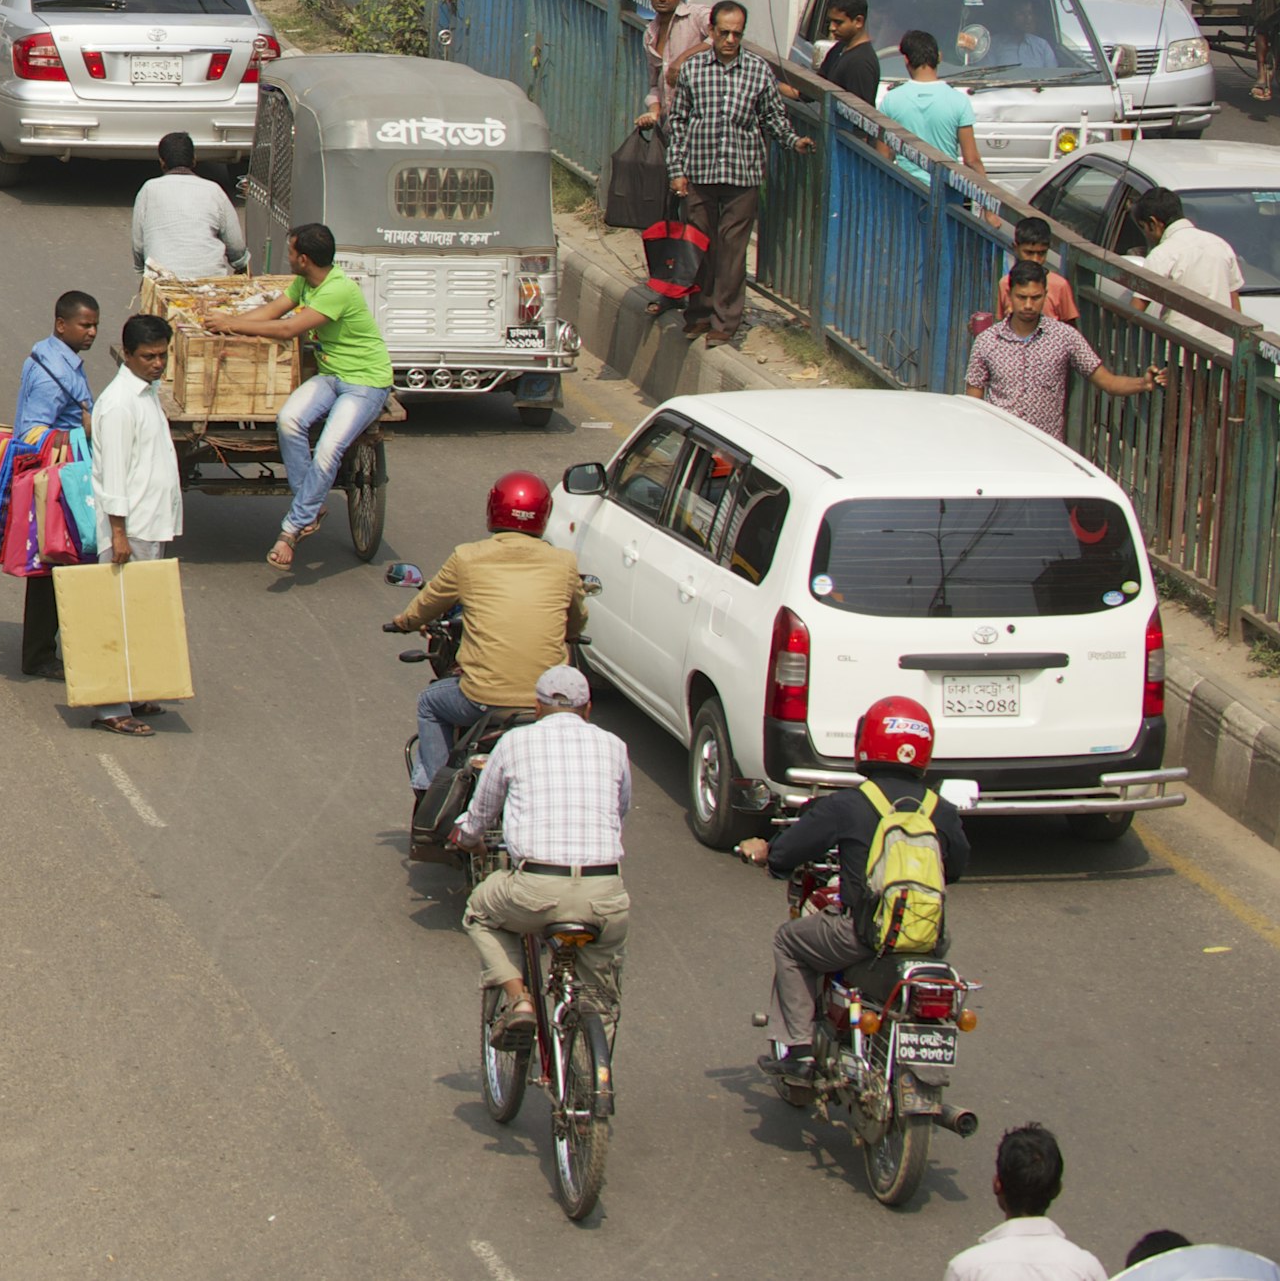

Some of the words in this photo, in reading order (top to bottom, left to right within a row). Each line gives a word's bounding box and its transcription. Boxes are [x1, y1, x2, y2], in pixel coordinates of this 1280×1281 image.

[376, 116, 507, 147] প্রাইভেট
[419, 230, 457, 246] আদায়
[947, 685, 970, 696] ঢাকা
[973, 682, 1016, 697] মেট্রো-গ
[945, 700, 1017, 714] ২১-২০৪৫
